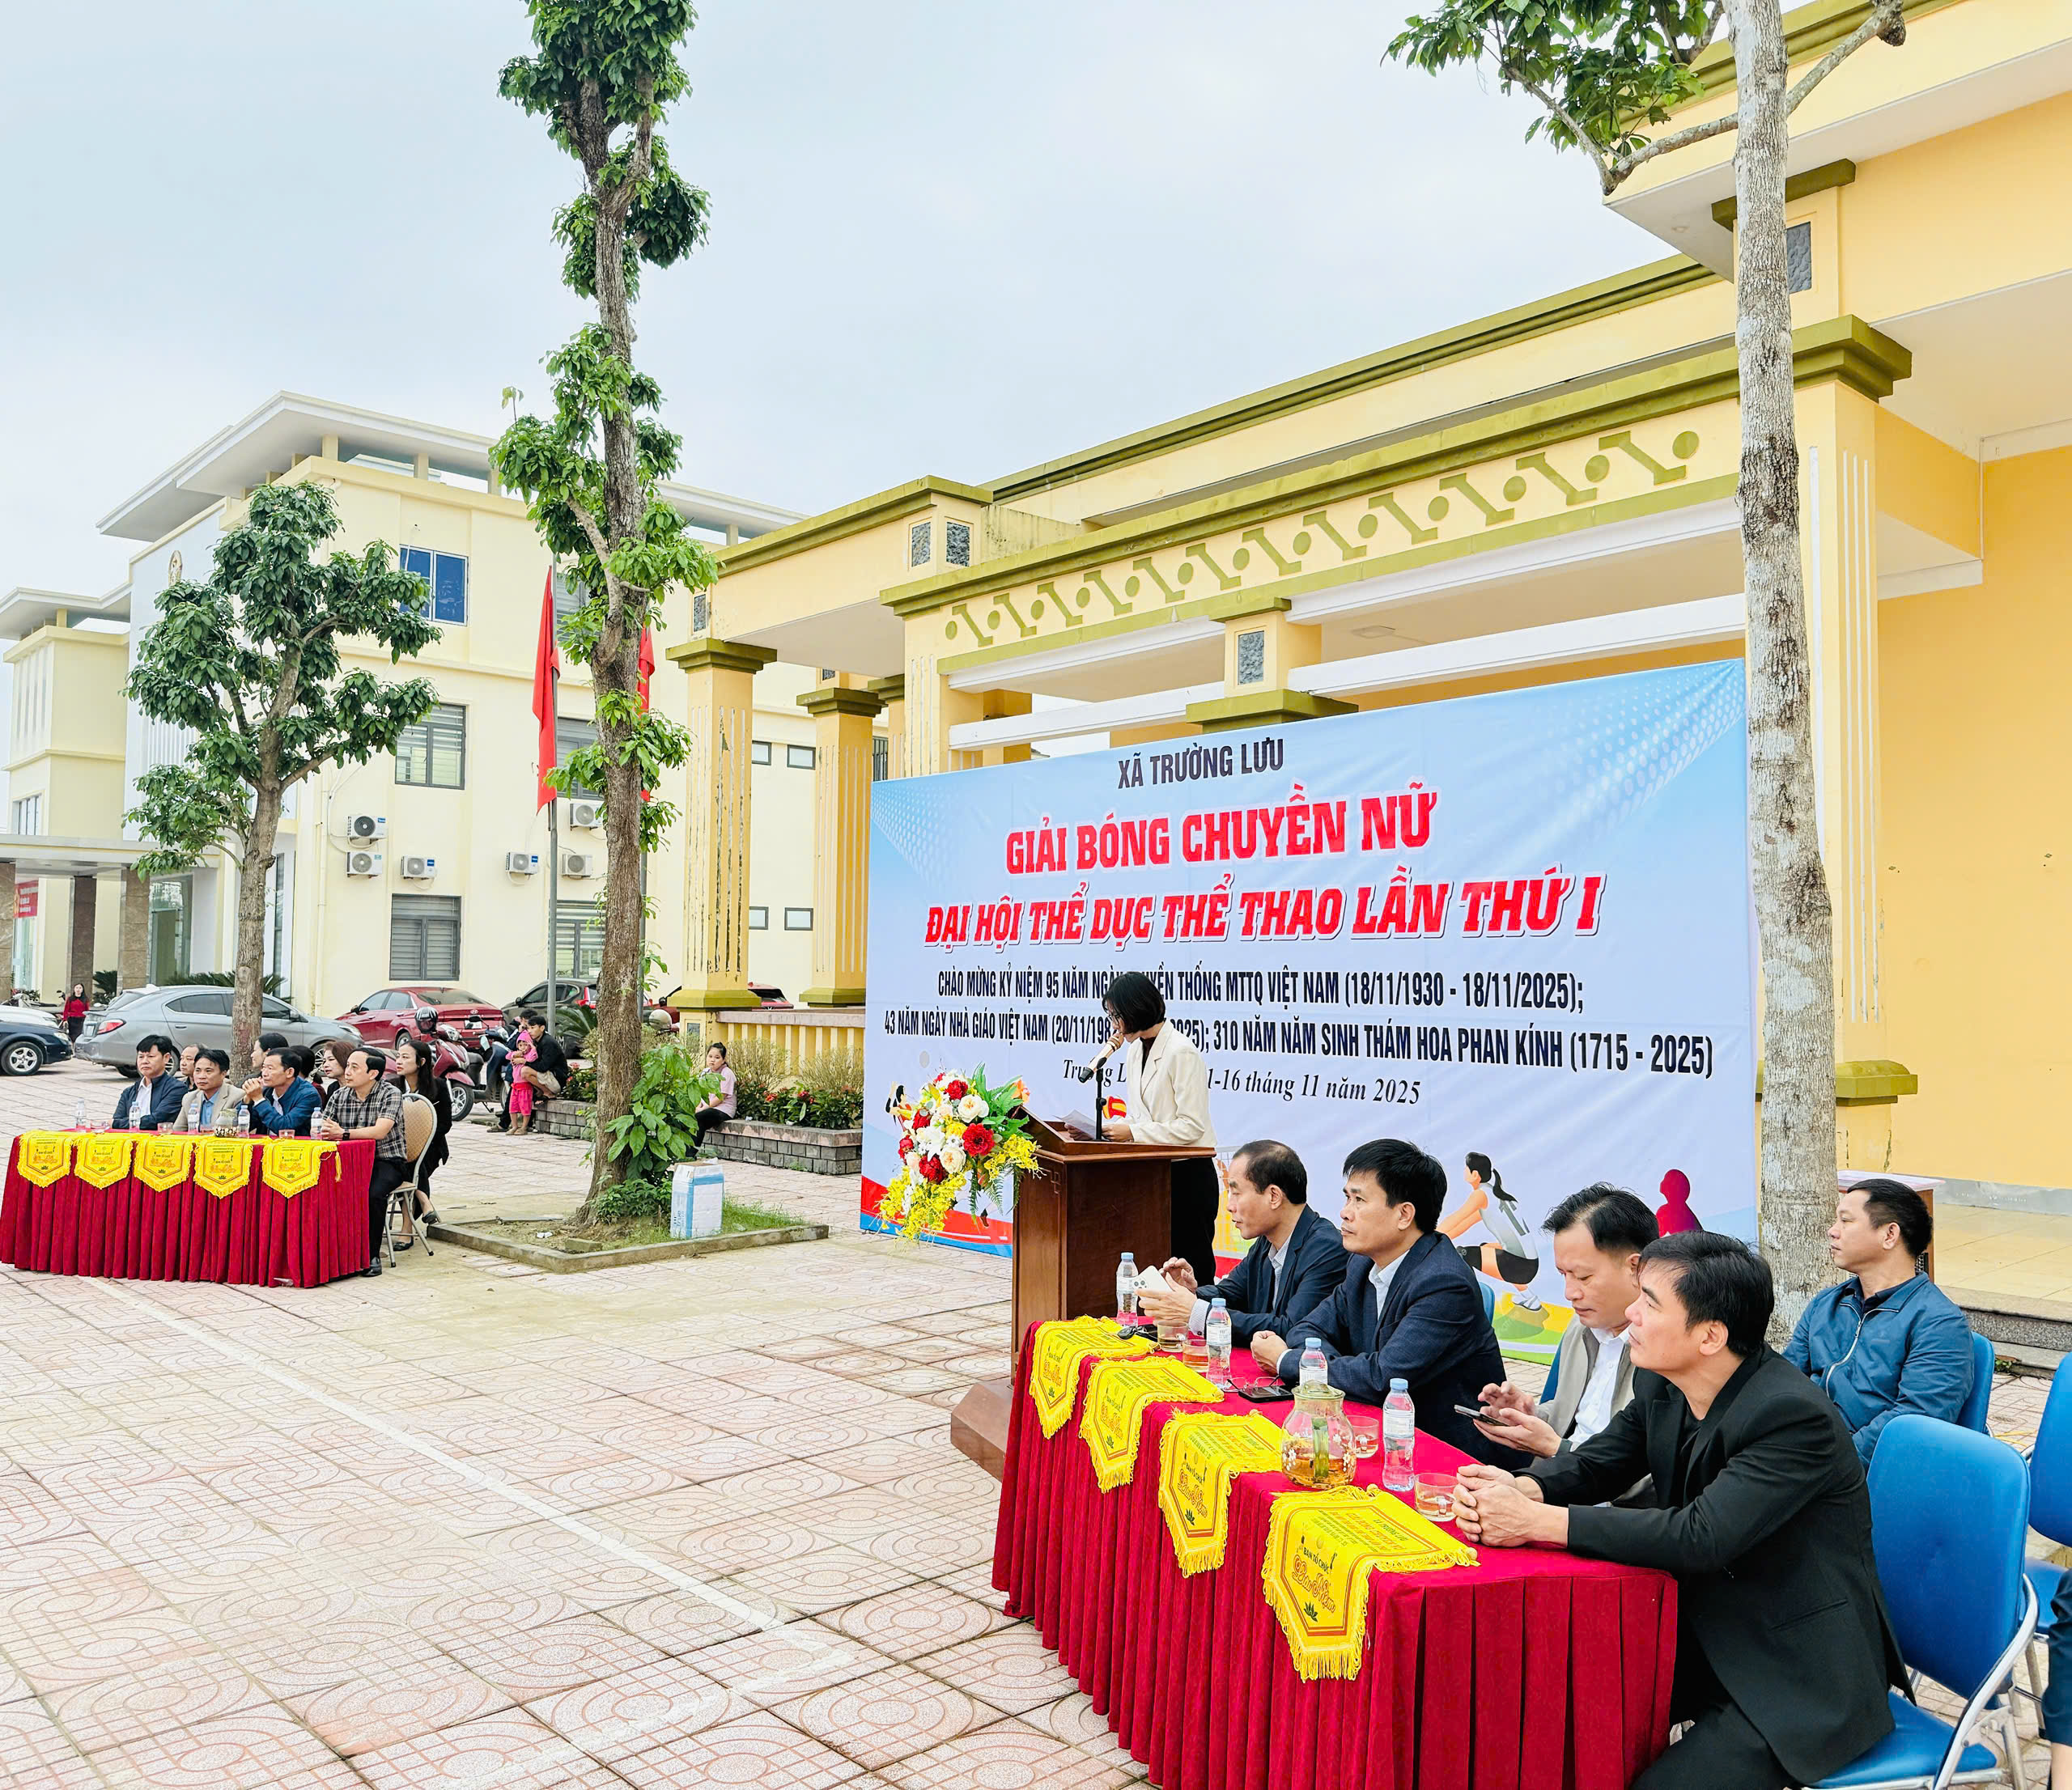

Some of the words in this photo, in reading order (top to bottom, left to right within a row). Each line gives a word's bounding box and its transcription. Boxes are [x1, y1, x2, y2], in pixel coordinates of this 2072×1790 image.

[1119, 751, 1143, 789] XÃ
[1150, 742, 1233, 785] TRƯỜNG
[1242, 737, 1284, 774] LƯU
[1006, 817, 1067, 875] GIẢI
[1077, 813, 1170, 870] BÓNG
[1182, 783, 1347, 863] CHUYỀN
[1361, 782, 1437, 851] NỮ
[925, 906, 970, 949] ĐẠI
[974, 895, 1022, 949] HỘI
[1029, 881, 1087, 940] THỂ
[1090, 897, 1153, 947] DỤC
[1161, 873, 1231, 938] THỂ
[1239, 888, 1343, 936] THAO
[1352, 865, 1450, 934] LẦN
[1461, 867, 1571, 932] THỨ
[1576, 876, 1602, 930] I
[938, 965, 963, 997] CHÀO
[966, 964, 996, 998] MỪNG
[1000, 961, 1013, 998] KỶ
[1016, 965, 1042, 1004] NIỆM
[1047, 971, 1059, 999] 95
[1063, 965, 1089, 999] NĂM
[1093, 965, 1123, 999] NGÀ
[1178, 960, 1221, 1002] THỐNG
[1226, 971, 1263, 1006] MTTQ
[1267, 965, 1298, 1010] VIỆT
[1304, 971, 1340, 1004] NAM
[1344, 971, 1444, 1008] (18/11/1930
[1463, 971, 1583, 1014] 18/11/2025);
[885, 1010, 895, 1035] 43
[898, 1005, 919, 1036] NĂM
[922, 1005, 947, 1037] NGÀY
[949, 1006, 970, 1038] NHÀ
[972, 1007, 996, 1039] GIÁO
[999, 1007, 1021, 1046] VIỆT
[1023, 1014, 1048, 1042] NAM
[1052, 1015, 1116, 1045] (20/11/198
[1214, 1020, 1238, 1051] 310
[1243, 1014, 1276, 1053] NĂM
[1281, 1015, 1316, 1055] NĂM
[1321, 1023, 1359, 1057] SINH
[1364, 1017, 1412, 1060] THÁM
[1417, 1026, 1453, 1062] HOA
[1458, 1028, 1509, 1065] PHAN
[1515, 1022, 1563, 1067] KÍNH
[1570, 1032, 1628, 1073] (1715
[1650, 1034, 1713, 1080] 2025)
[1246, 1071, 1295, 1101] tháng
[1301, 1074, 1319, 1097] 11
[1326, 1076, 1366, 1101] năm
[1373, 1078, 1420, 1105] 2025
